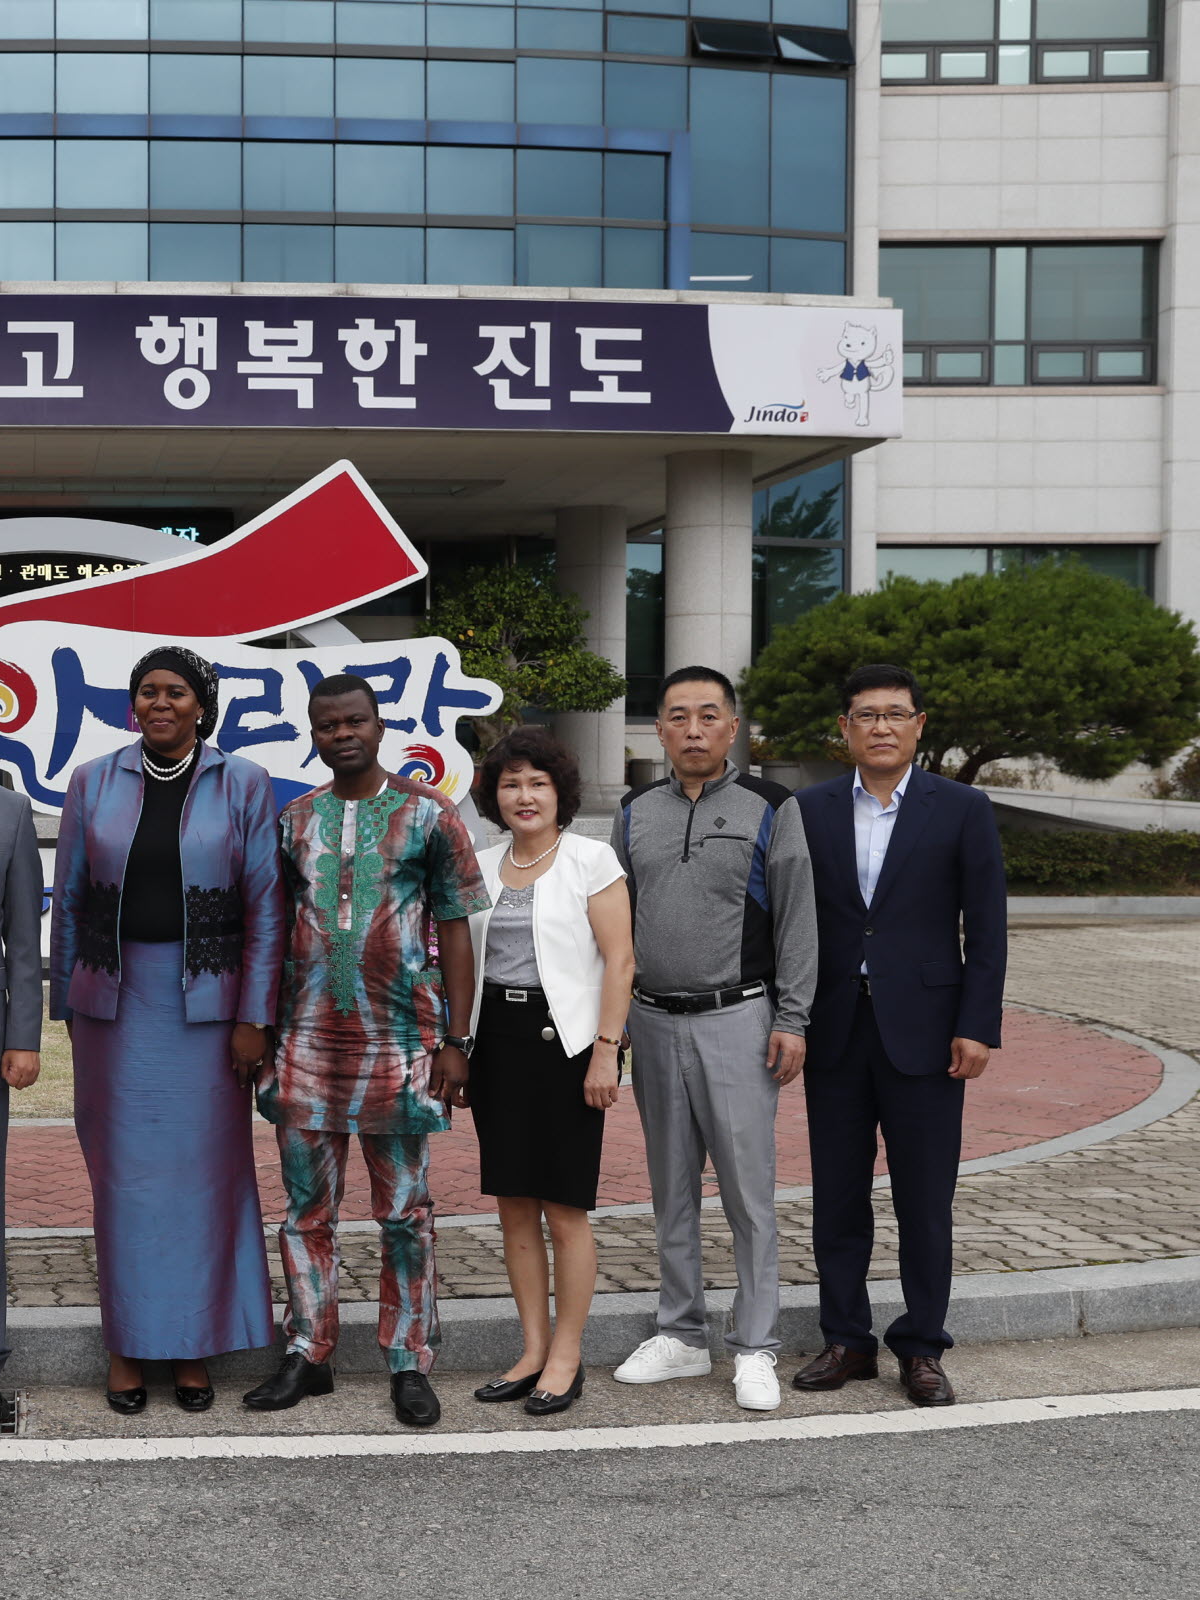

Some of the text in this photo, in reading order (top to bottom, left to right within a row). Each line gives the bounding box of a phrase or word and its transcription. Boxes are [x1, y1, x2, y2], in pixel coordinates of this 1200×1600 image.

[136, 316, 428, 410] 행복한
[473, 322, 651, 410] 진도
[744, 406, 798, 423] Jindo
[19, 564, 70, 581] 관매도
